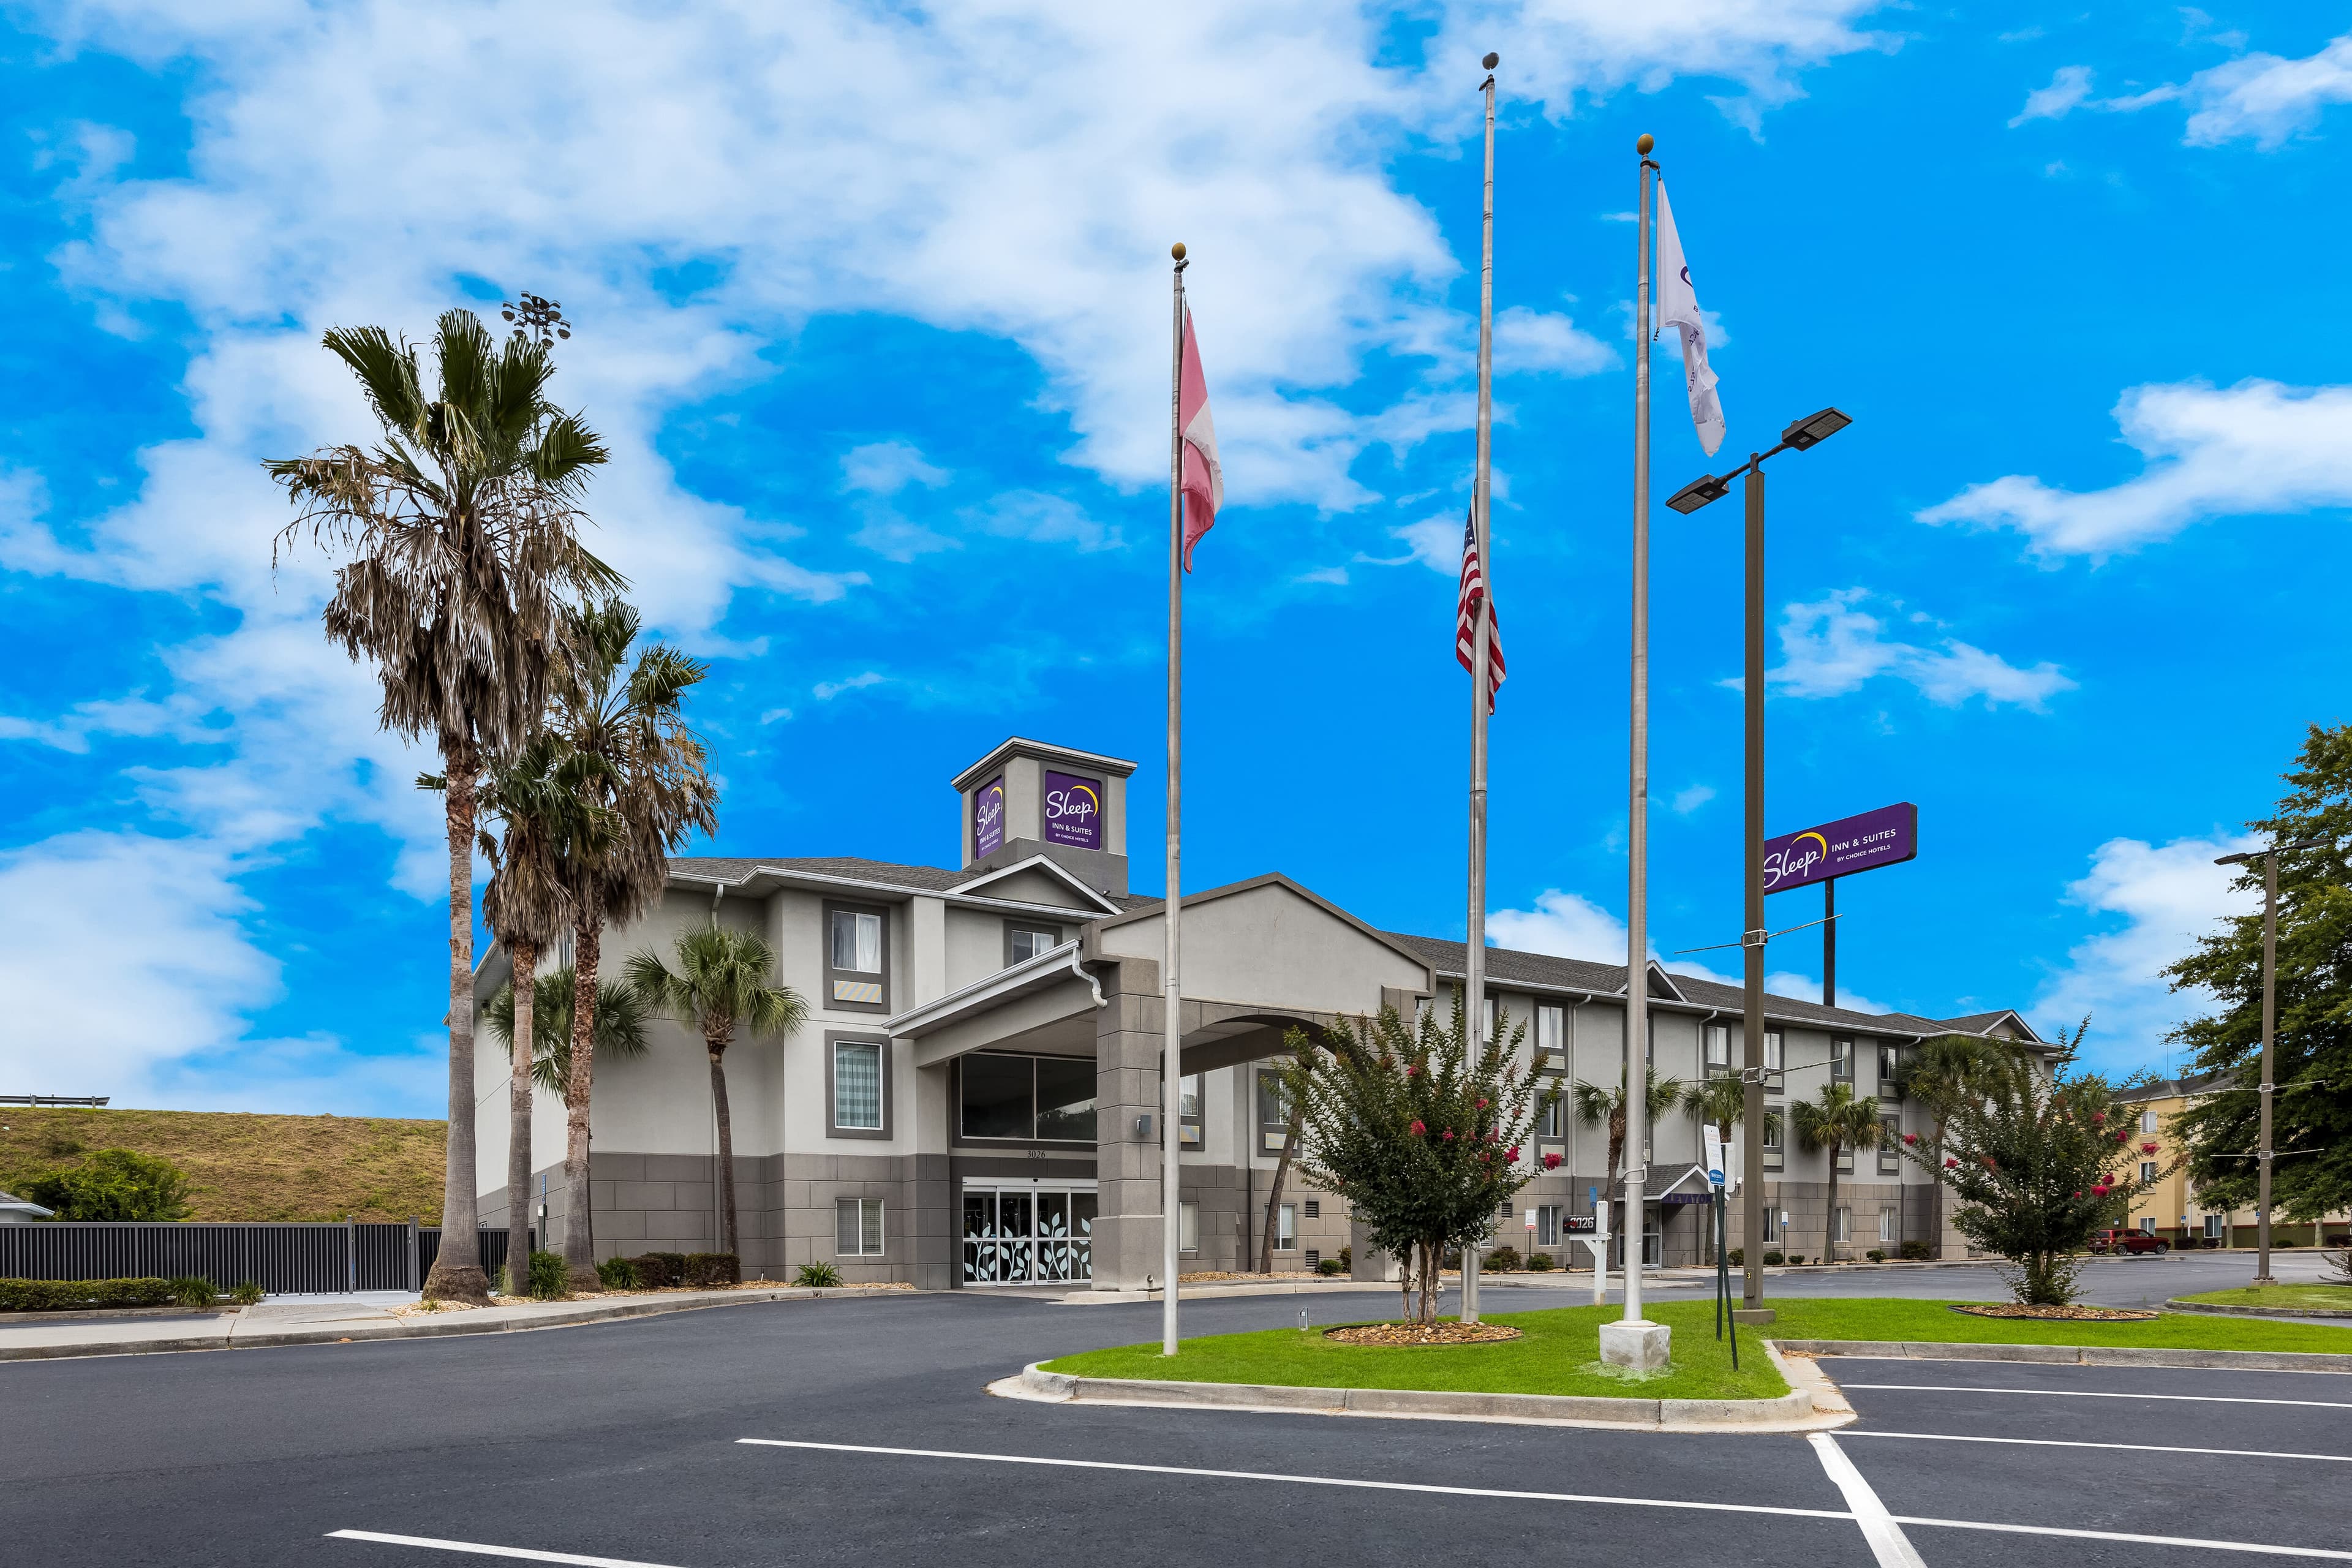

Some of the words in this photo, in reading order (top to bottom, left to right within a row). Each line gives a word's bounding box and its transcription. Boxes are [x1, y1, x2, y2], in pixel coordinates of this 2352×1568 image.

[977, 801, 1001, 836] Sleep
[1046, 791, 1093, 823] Sleep
[989, 827, 1000, 839] SUITES
[1071, 826, 1092, 835] SUITES
[1831, 841, 1849, 853] INN
[1863, 829, 1896, 844] SUITES
[1845, 850, 1867, 860] CHOICE
[1868, 844, 1891, 854] HOTELS
[1764, 848, 1820, 888] Sleep
